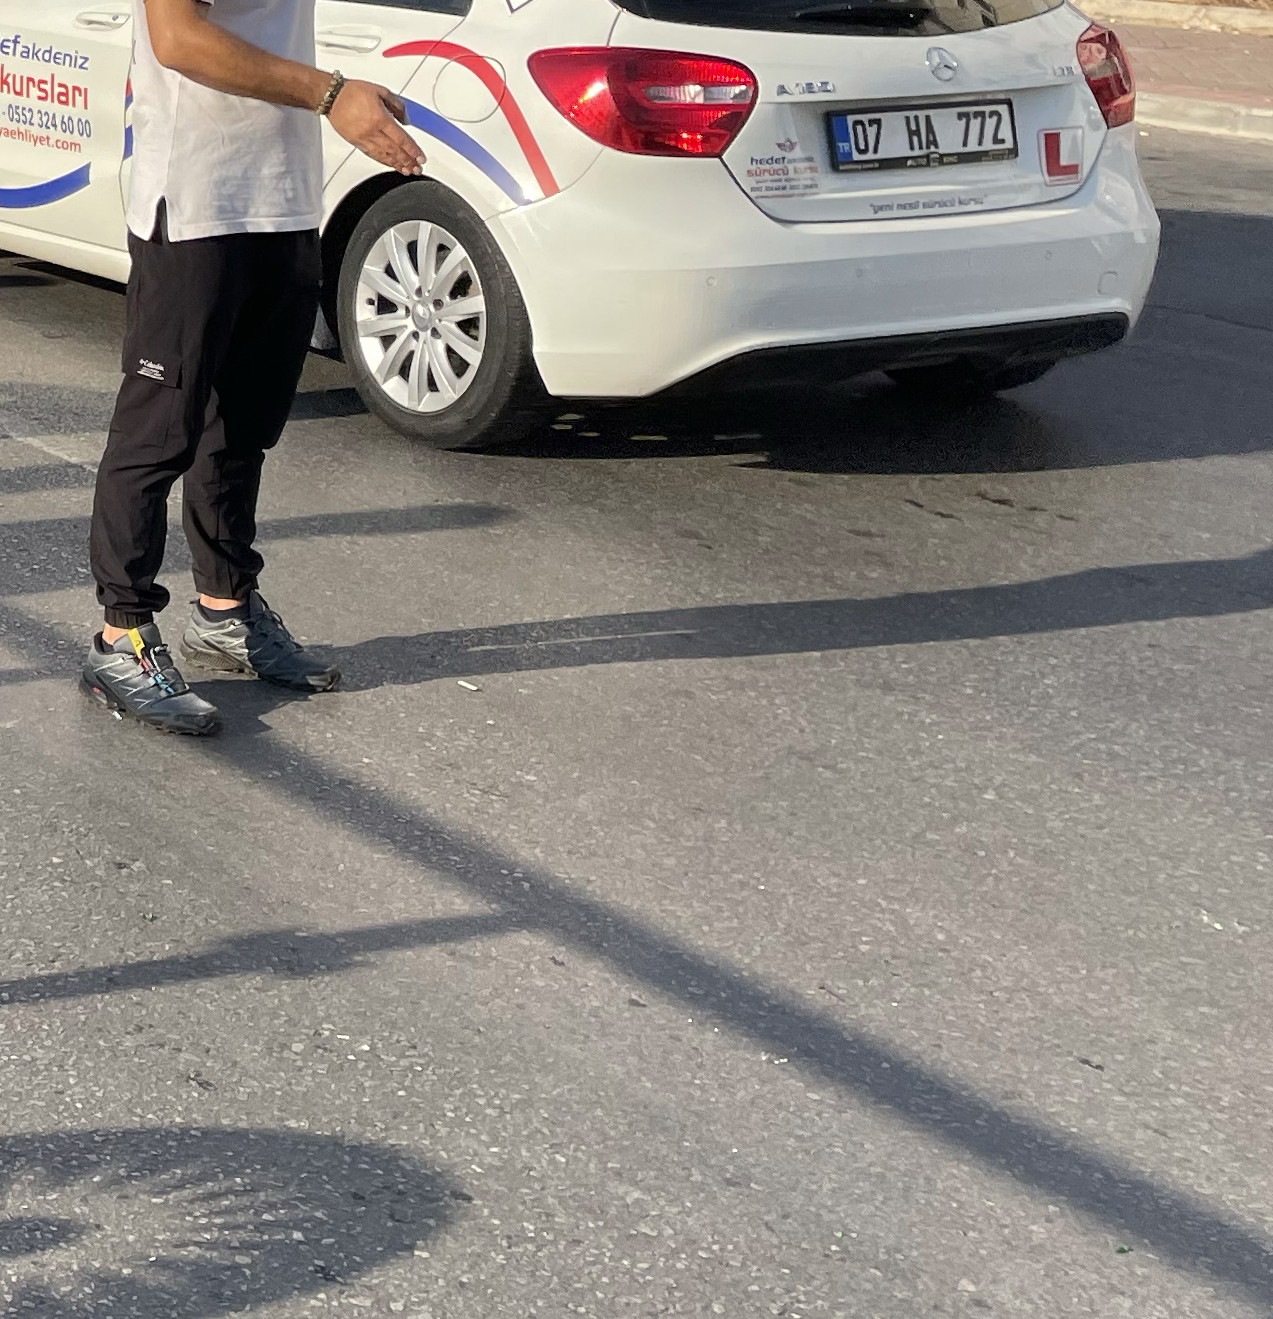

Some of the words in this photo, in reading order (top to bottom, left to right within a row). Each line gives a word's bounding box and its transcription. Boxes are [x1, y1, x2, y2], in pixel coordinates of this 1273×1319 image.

[0, 63, 88, 110] kursları
[8, 103, 34, 126] 0552
[36, 109, 58, 132] 324
[60, 115, 74, 135] 60
[77, 118, 92, 138] 00
[852, 117, 883, 155] 07
[904, 114, 940, 151] HA
[957, 110, 1006, 147] 772
[838, 142, 851, 153] TR
[1044, 131, 1079, 177] L
